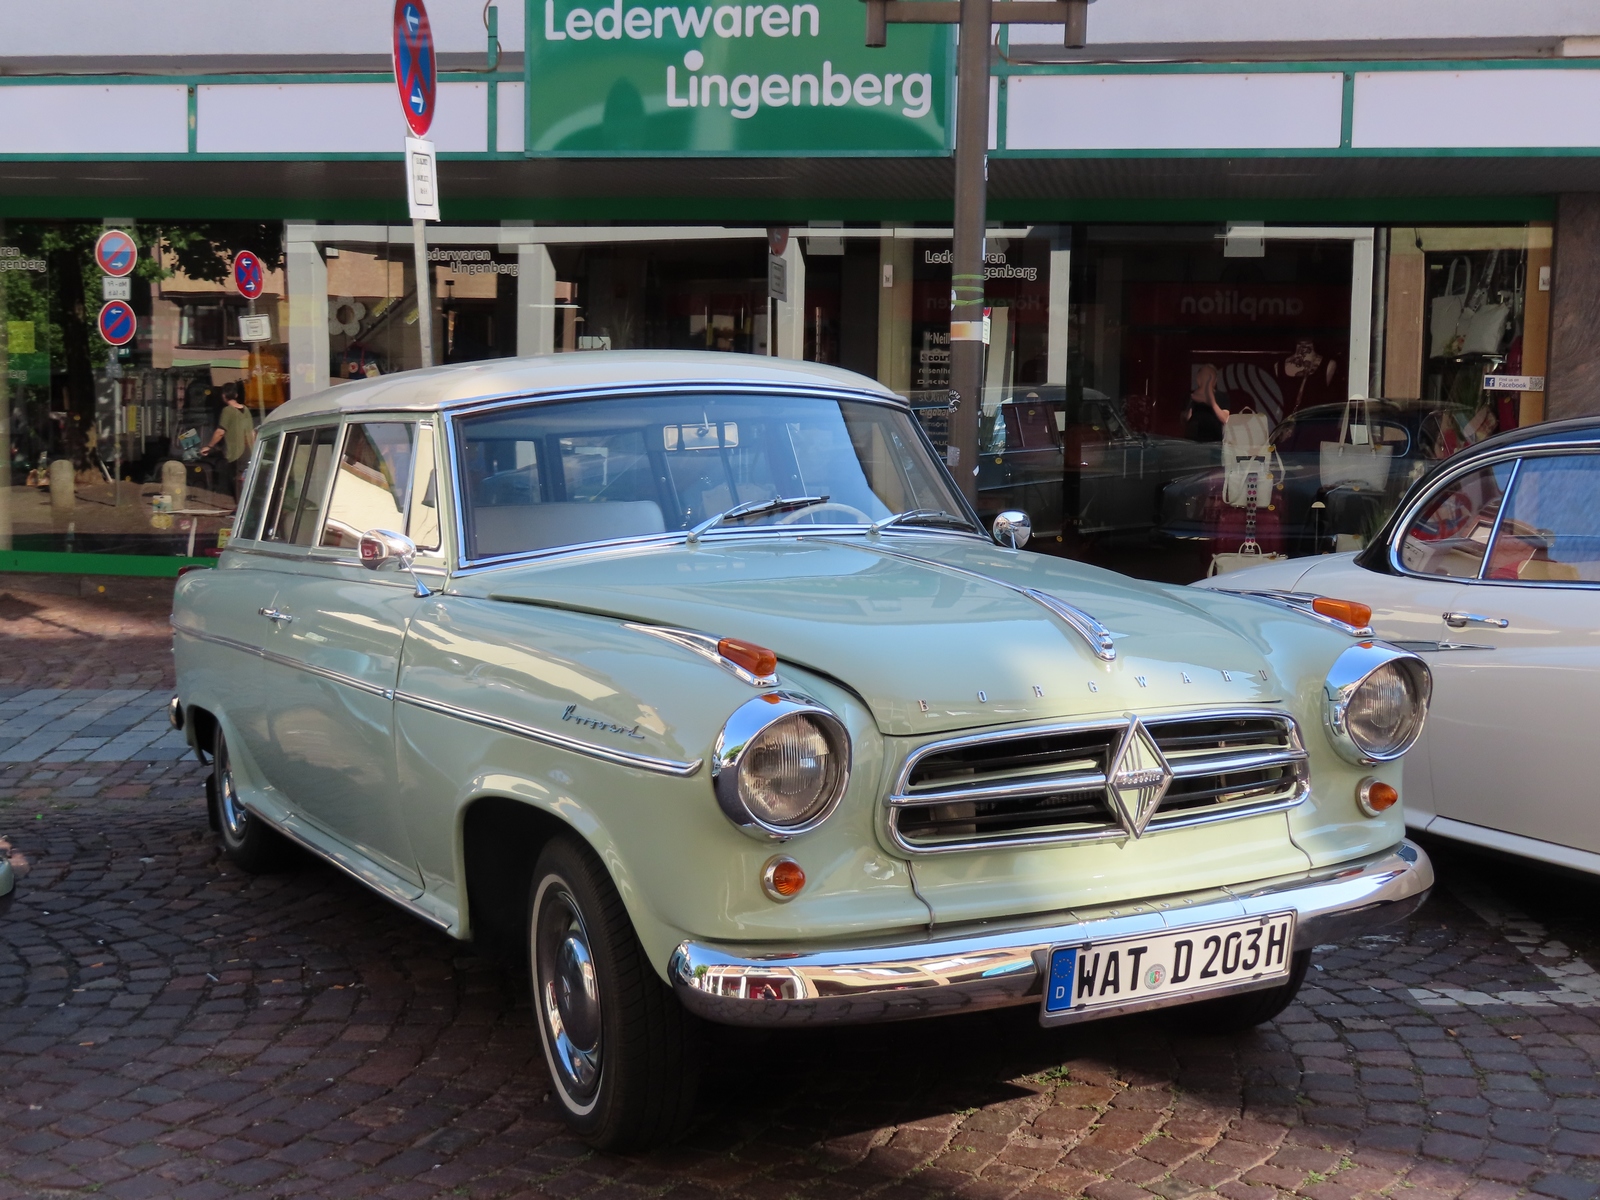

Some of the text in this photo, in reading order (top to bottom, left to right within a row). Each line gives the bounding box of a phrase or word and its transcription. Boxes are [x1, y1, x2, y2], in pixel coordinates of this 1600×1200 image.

[544, 0, 820, 40] Lederwaren
[667, 51, 932, 119] Lingenberg
[427, 247, 491, 261] ederwaren
[451, 260, 519, 277] Lingenberg
[1498, 381, 1527, 389] Facebook
[1055, 986, 1065, 999] D
[1077, 946, 1148, 998] WAT
[1171, 939, 1194, 985] D
